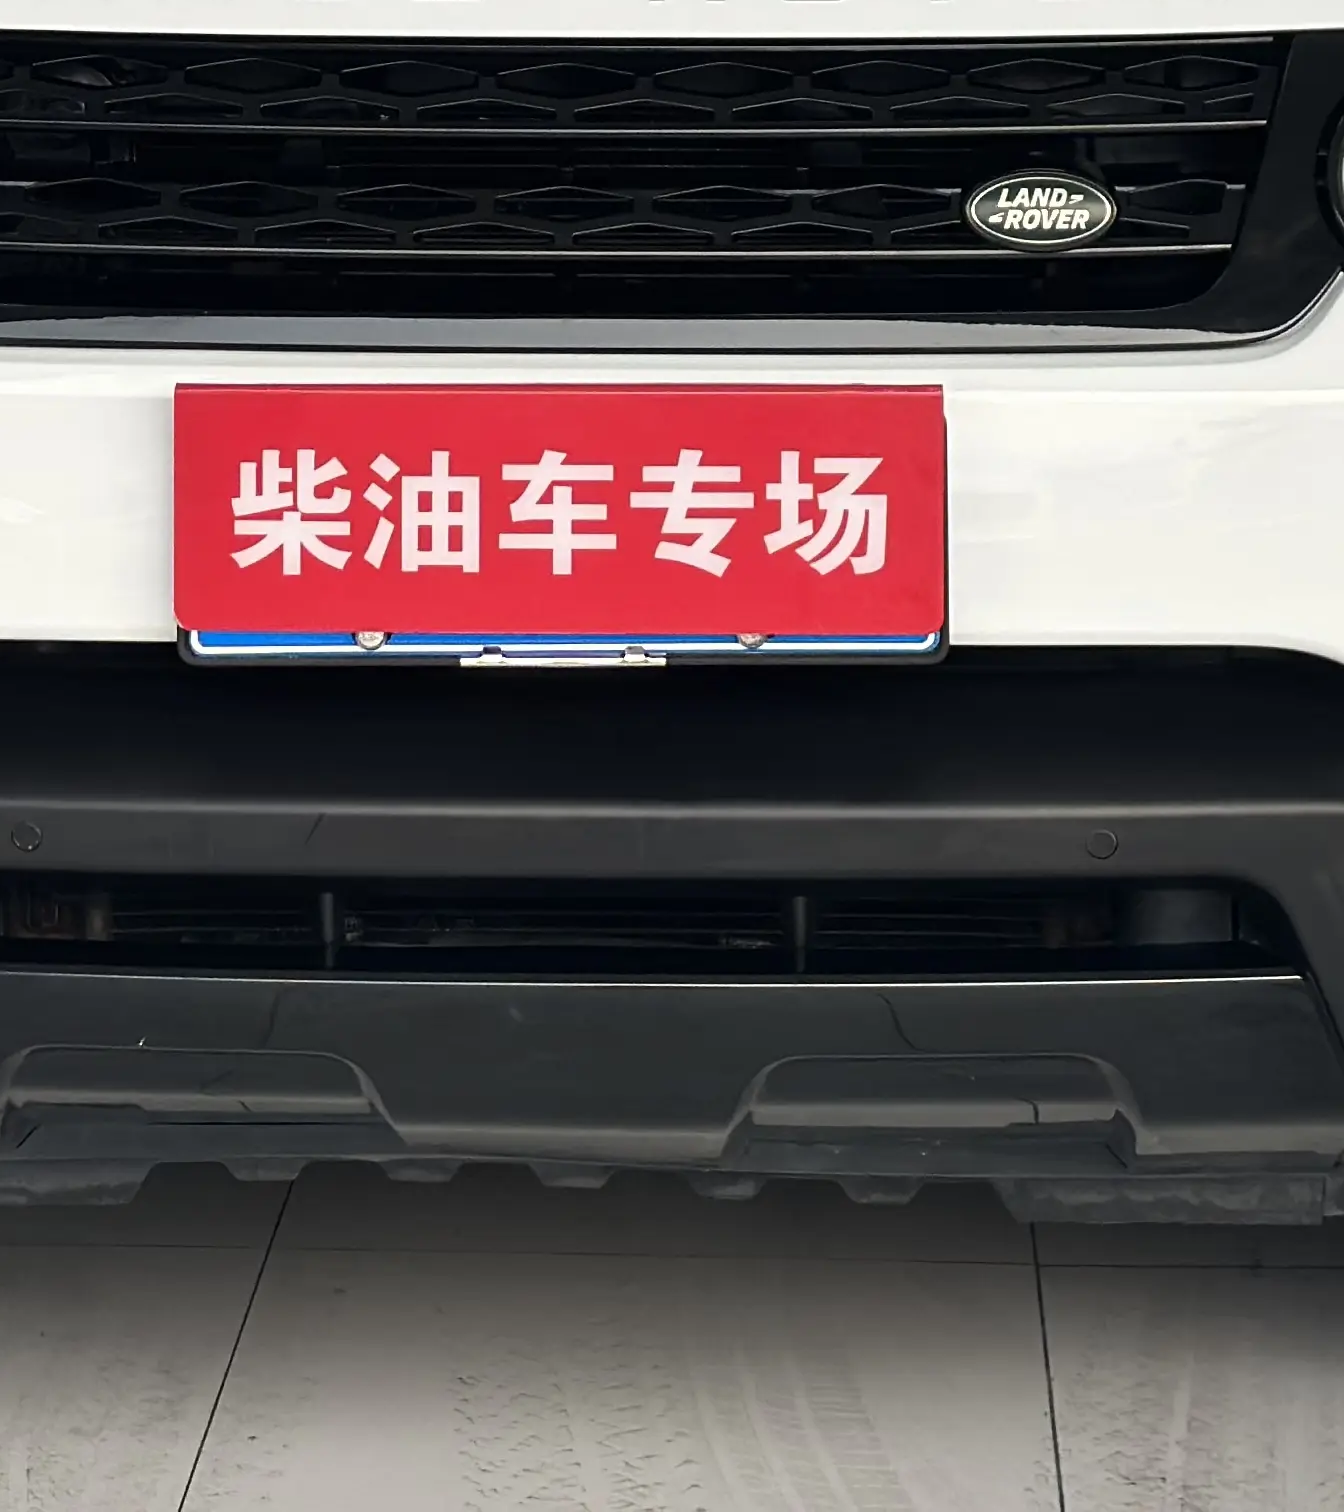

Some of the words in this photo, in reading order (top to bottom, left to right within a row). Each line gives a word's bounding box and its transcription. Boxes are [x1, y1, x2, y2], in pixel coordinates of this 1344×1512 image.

[997, 187, 1068, 208] LAND
[1003, 208, 1091, 230] ROVER
[230, 448, 889, 579] 柴油车专场
